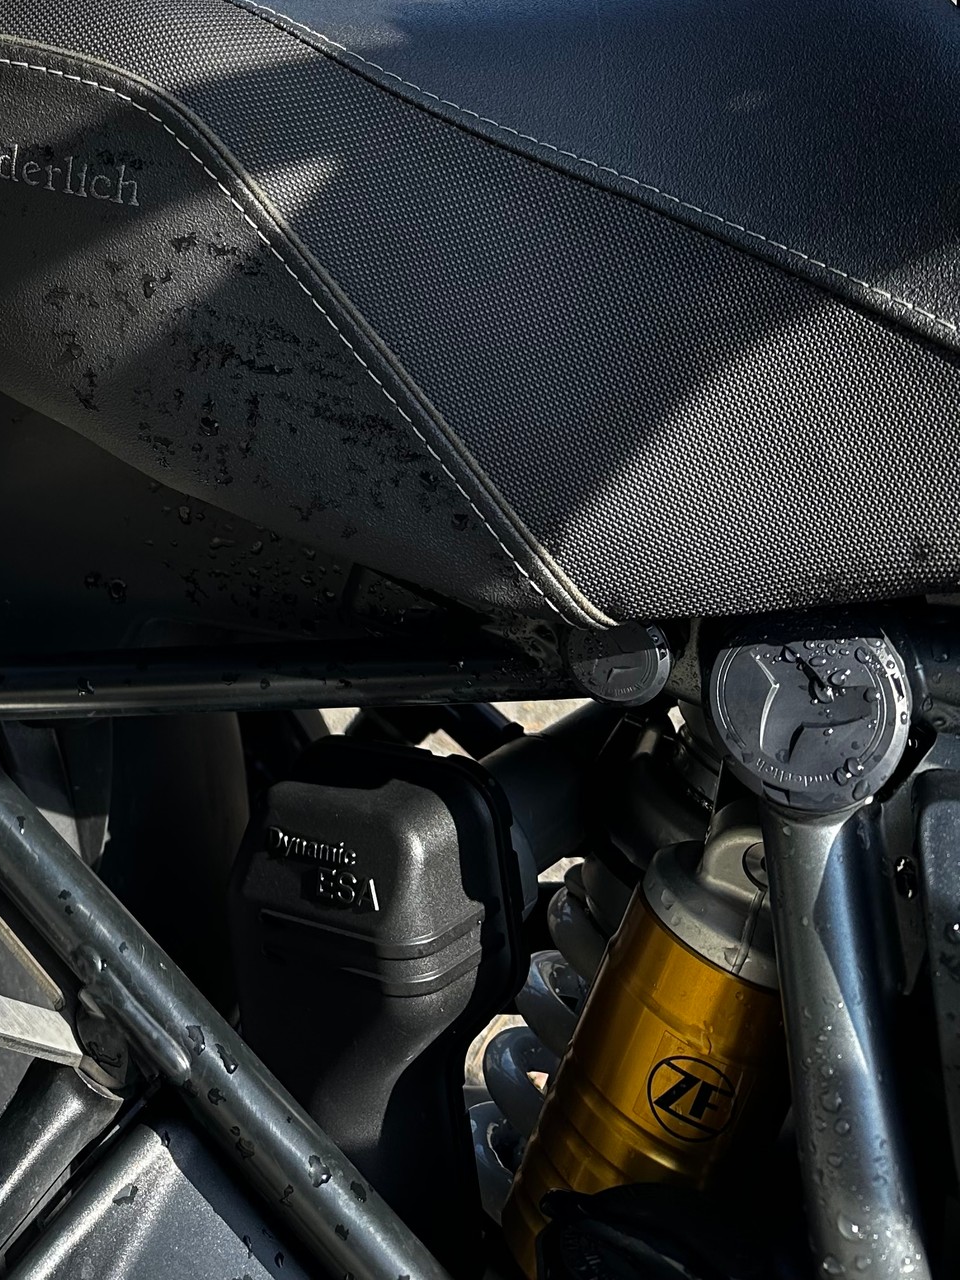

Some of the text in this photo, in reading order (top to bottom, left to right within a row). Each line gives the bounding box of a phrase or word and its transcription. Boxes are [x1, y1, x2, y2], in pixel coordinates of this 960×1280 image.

[269, 826, 357, 866] Dynamic
[318, 868, 380, 912] ESA
[651, 1058, 736, 1136] ZF
